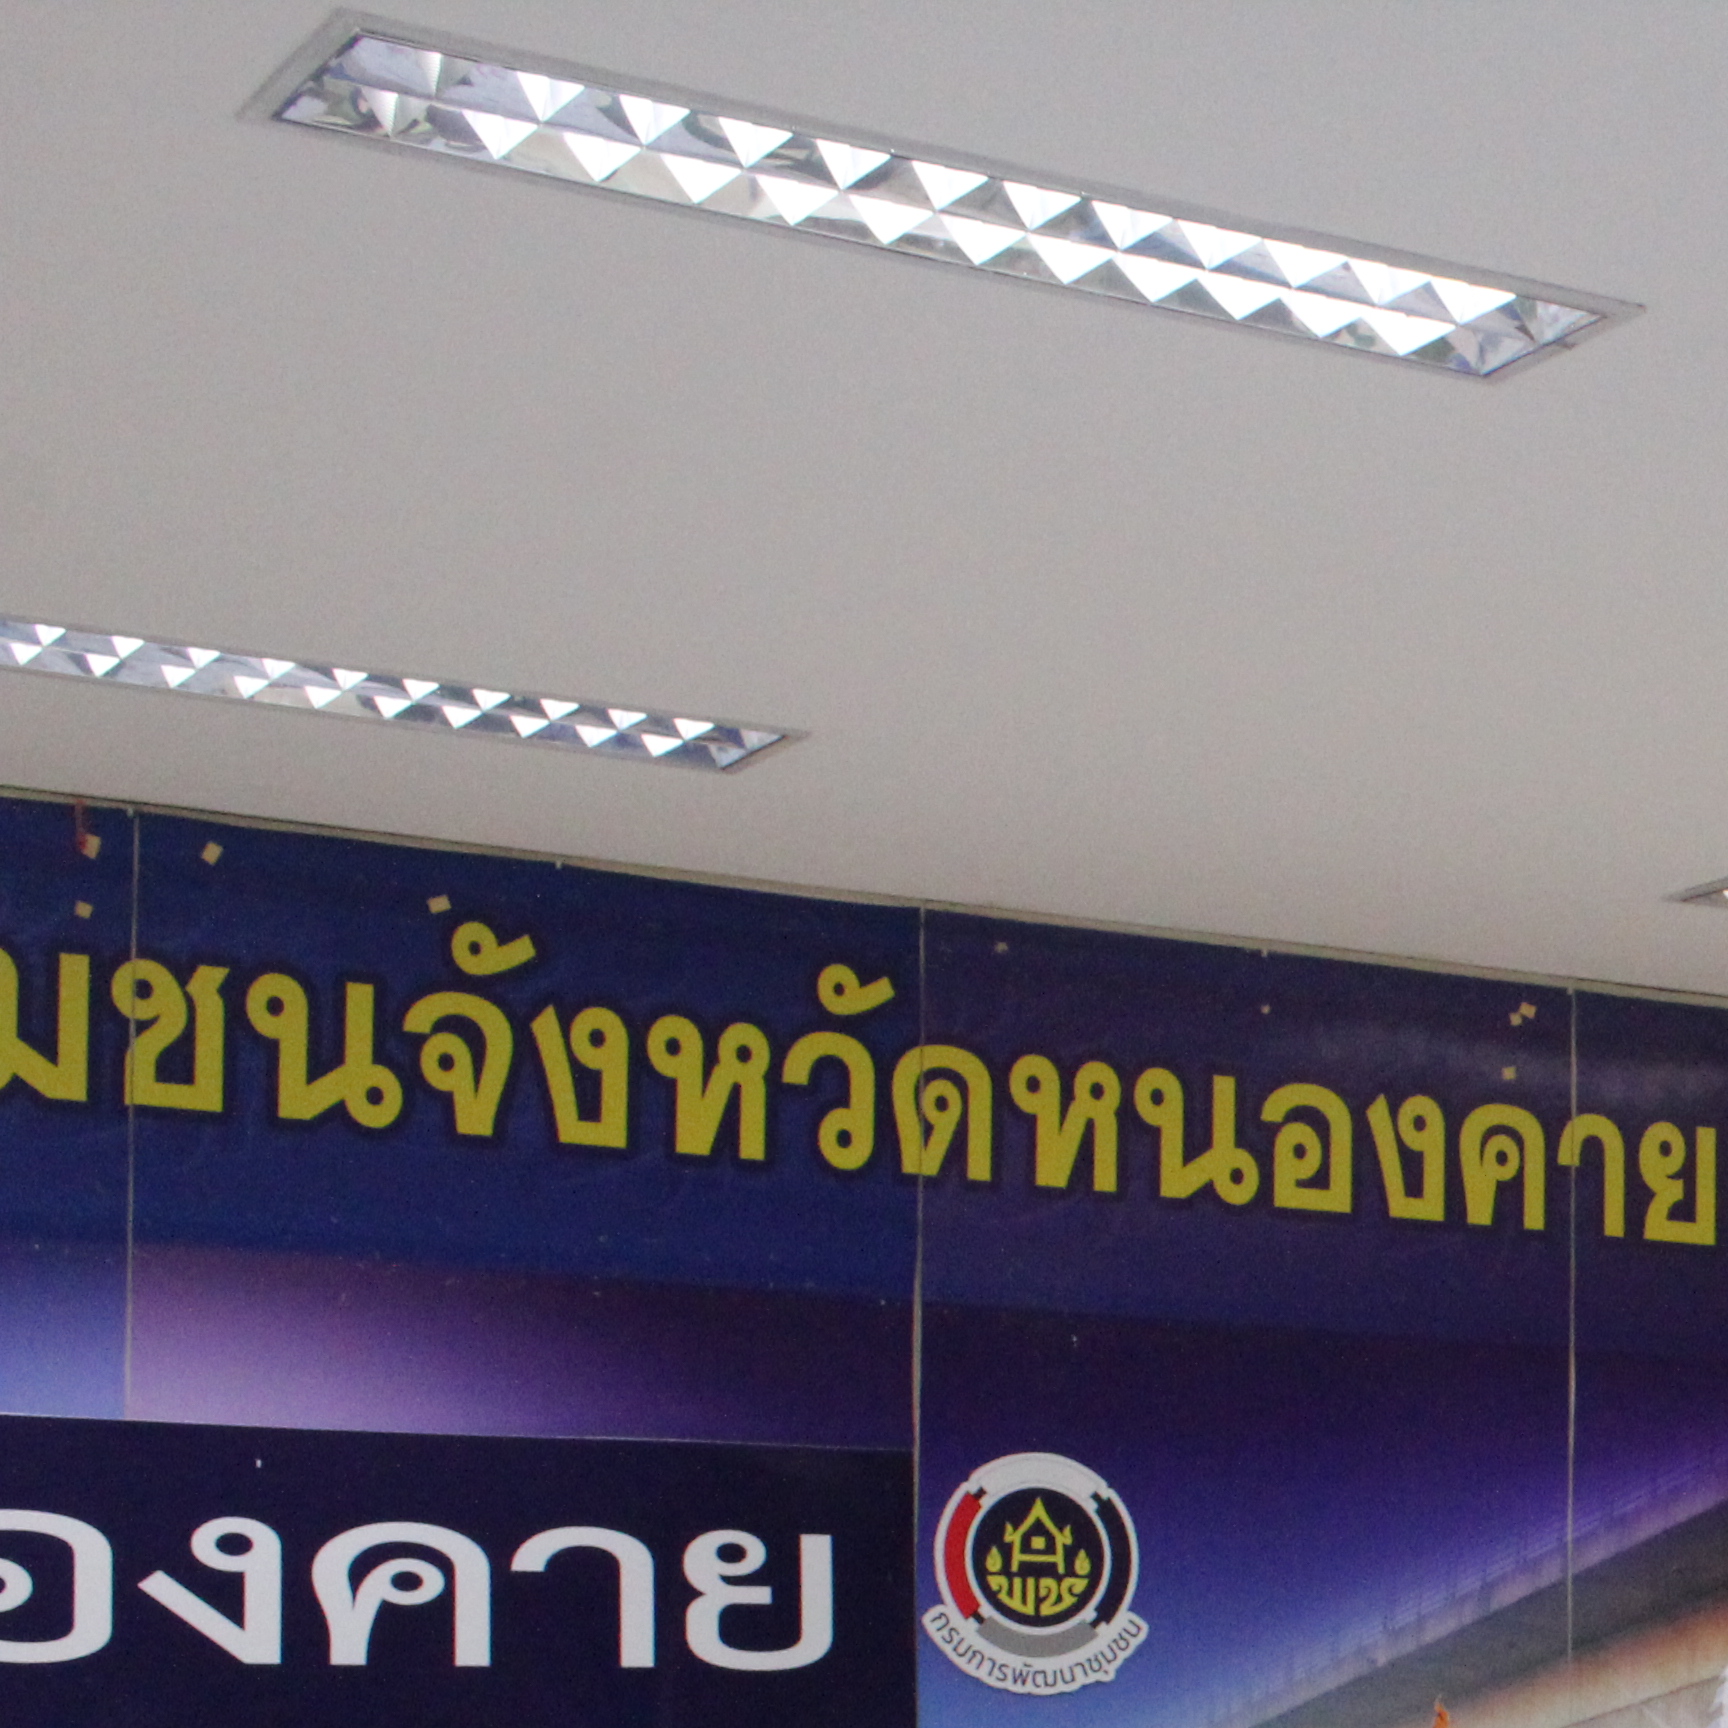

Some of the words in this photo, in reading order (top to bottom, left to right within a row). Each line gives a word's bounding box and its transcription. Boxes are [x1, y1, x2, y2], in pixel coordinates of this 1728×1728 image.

[0, 1508, 834, 1672] องคาย
[929, 1612, 1143, 1689] กรมการพัฒนาชุมชน
